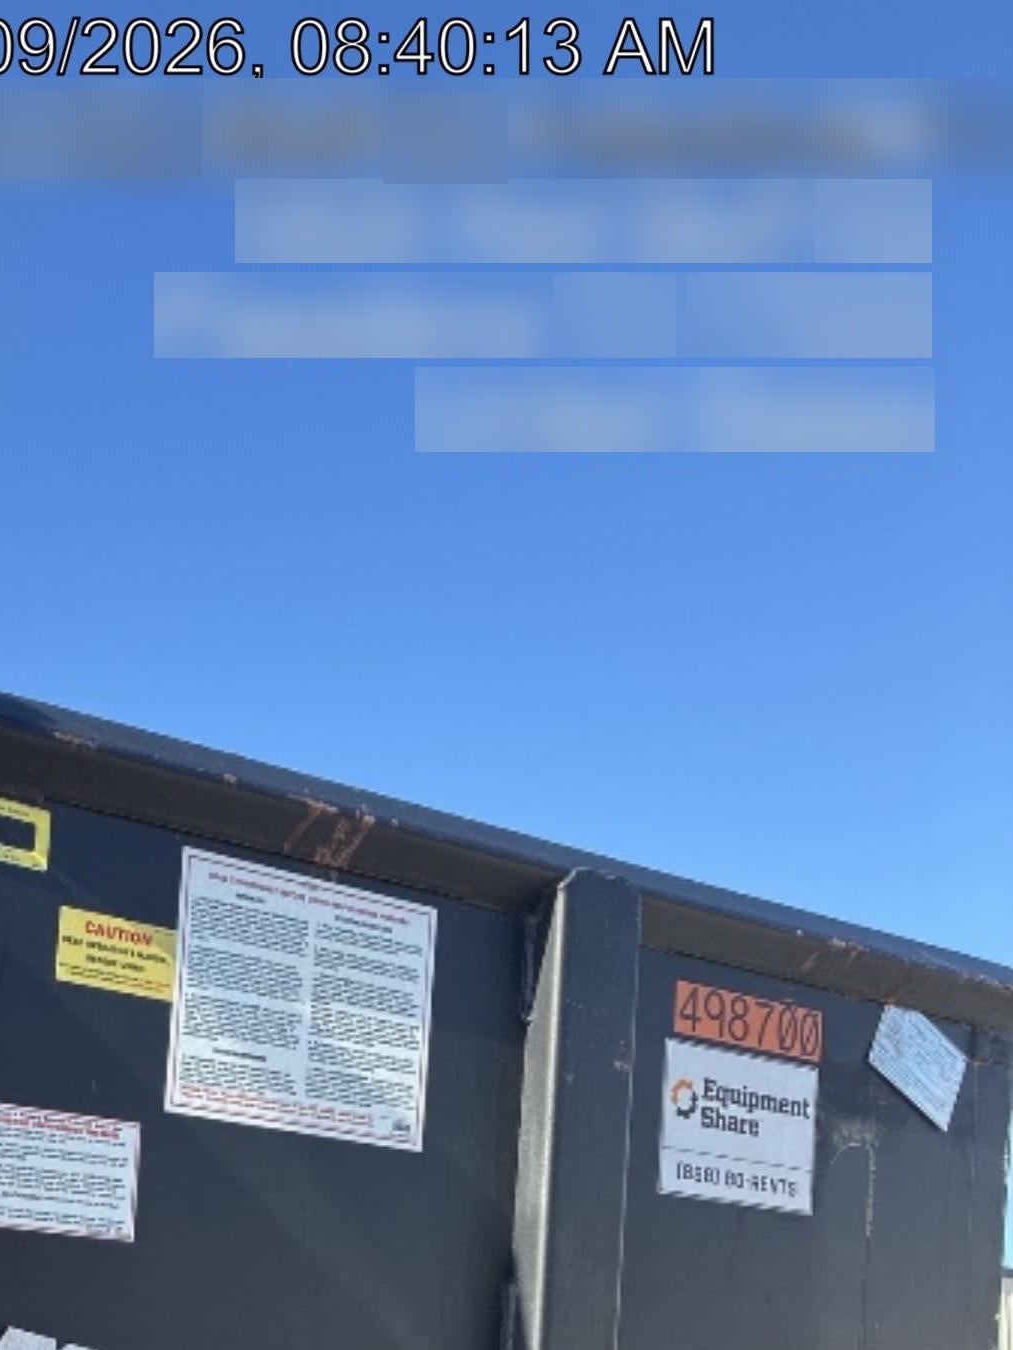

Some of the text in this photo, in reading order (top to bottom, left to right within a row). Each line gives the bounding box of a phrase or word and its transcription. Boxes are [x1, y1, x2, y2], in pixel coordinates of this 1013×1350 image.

[85, 920, 152, 946] CAUTION
[679, 986, 819, 1056] 498700
[702, 1077, 810, 1119] Equipment
[700, 1106, 760, 1137] Share
